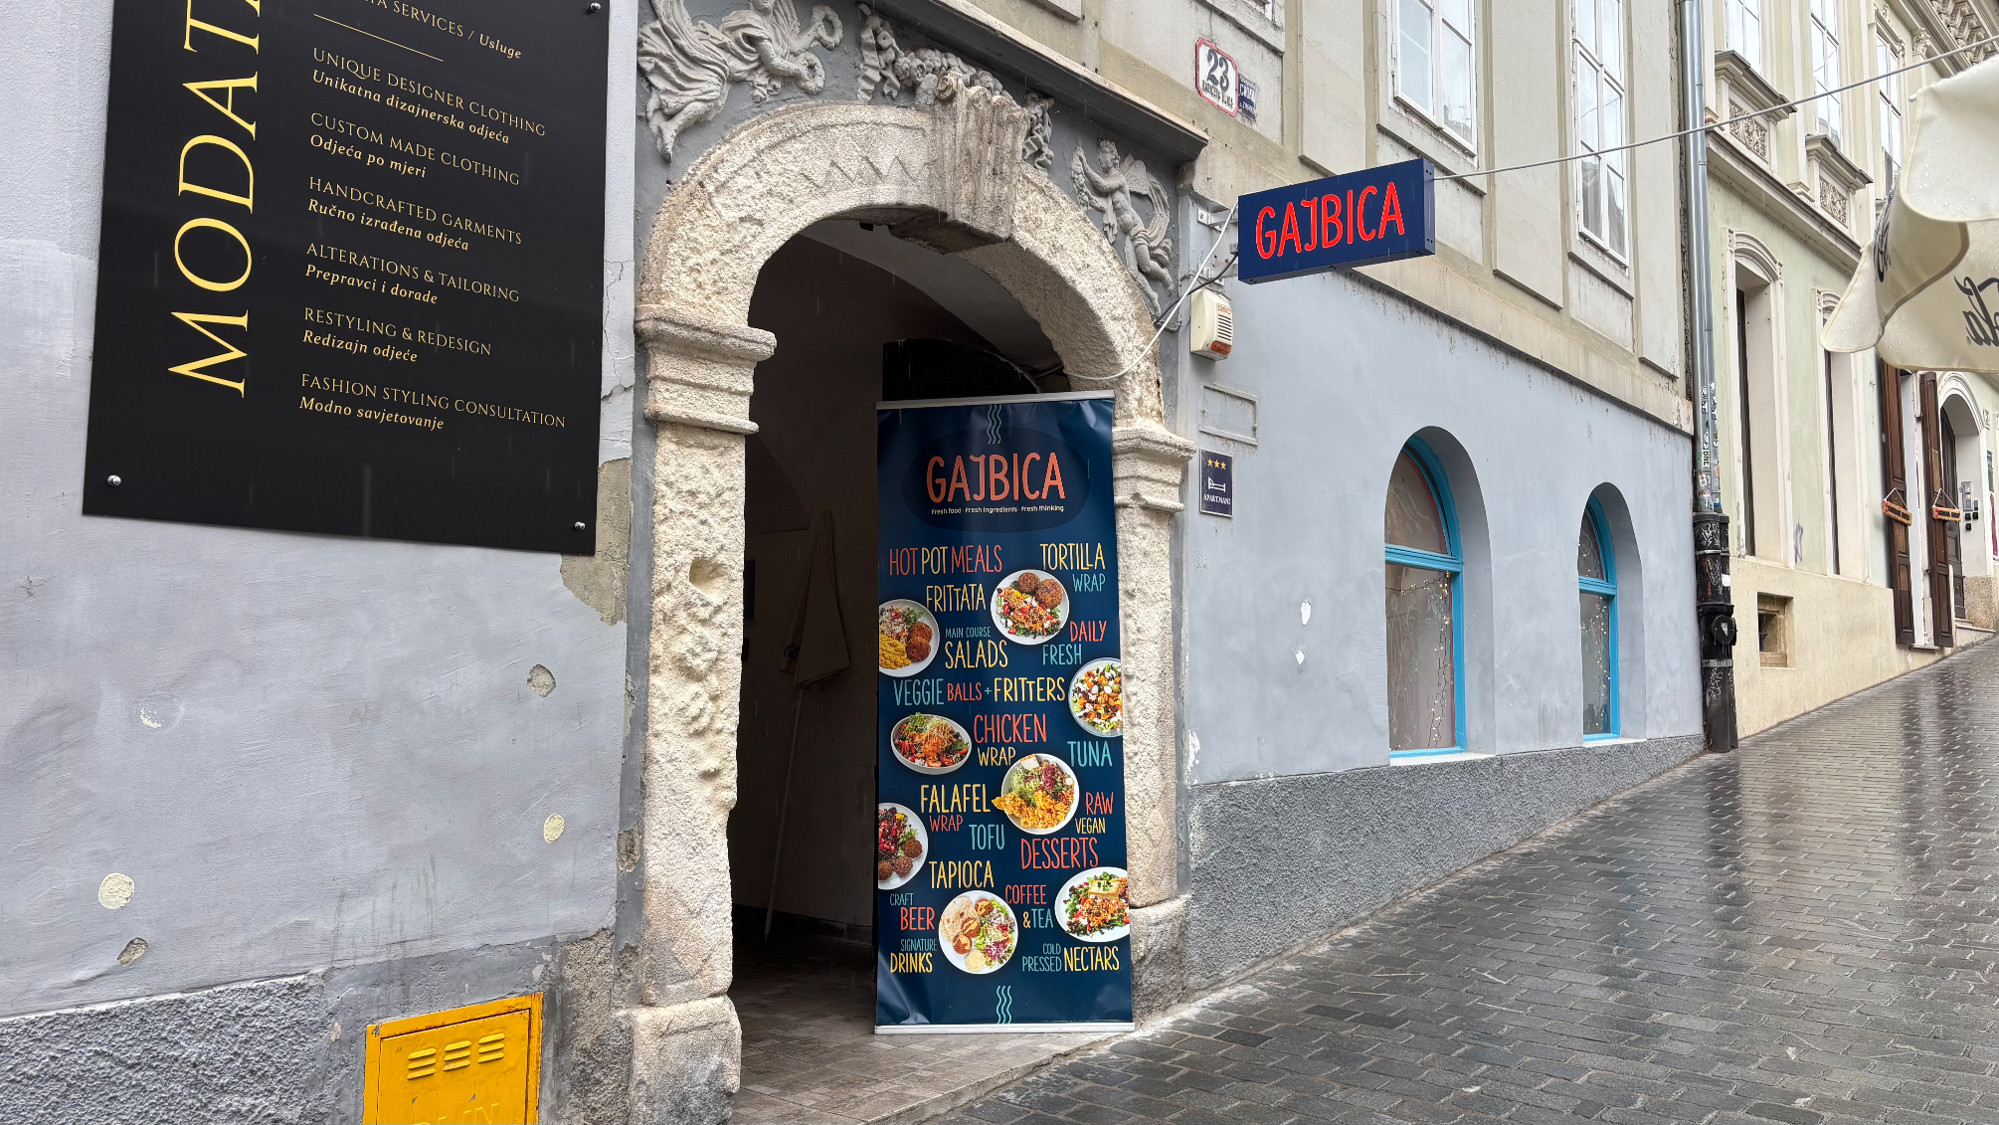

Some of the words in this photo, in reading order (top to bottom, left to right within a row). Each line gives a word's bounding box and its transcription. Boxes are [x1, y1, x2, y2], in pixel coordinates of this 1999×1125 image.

[393, 0, 464, 37] SERVICES
[479, 34, 522, 59] Usluge
[1207, 48, 1229, 92] 23
[313, 47, 381, 81] UNIQUE
[388, 72, 465, 110] DESIGNER
[469, 101, 546, 136] CLOTHING
[312, 69, 381, 102] Unikatna
[386, 95, 464, 129] dizajnerska
[469, 123, 509, 144] odjeća
[310, 112, 384, 145] CUSTOM
[390, 136, 436, 161] MADE
[440, 152, 520, 186] CLOTHING
[310, 134, 362, 160] Odjeća
[367, 153, 384, 166] po
[390, 159, 427, 179] mjeri
[168, 0, 261, 398] MODAT
[309, 176, 437, 222] HANDCRAFTED
[441, 213, 522, 245] GARMENTS
[308, 199, 355, 222] Ručno
[360, 213, 422, 239] izrađena
[426, 232, 469, 251] odjeća
[1255, 181, 1405, 260] GAJBICA
[306, 243, 419, 280] ALTERATIONS
[423, 269, 435, 283] &
[438, 272, 520, 303] TAILORING
[306, 264, 377, 291] Prepravci
[381, 280, 387, 293] i
[391, 283, 438, 304] dorade
[302, 329, 368, 354] Redizajn
[373, 345, 418, 363] odjeće
[304, 307, 397, 338] RESTYLING
[402, 327, 413, 341] &
[418, 329, 492, 356] REDESIGN
[299, 396, 352, 416] Modno
[356, 407, 445, 432] savjetovanje
[301, 373, 377, 398] FASHION
[383, 387, 449, 410] STYLING
[454, 399, 566, 428] CONSULTATION
[926, 452, 1065, 503] GAJBICA
[1038, 504, 1064, 512] thinking
[889, 547, 918, 576] HOT
[921, 546, 948, 575] POT
[951, 544, 1003, 574] MEALS
[1040, 542, 1106, 570] TORTILLA
[1072, 573, 1106, 593] WRAP
[926, 584, 986, 613] FRITTATA
[945, 627, 964, 638] MAIN
[966, 626, 991, 638] COURSE
[1070, 620, 1107, 642] DAILY
[945, 640, 1008, 669] SALADS
[1042, 644, 1082, 666] FRESH
[893, 678, 945, 706] VEGGIE
[947, 682, 982, 701] BALLS
[994, 677, 1065, 702] FRITTERS
[973, 714, 1047, 744] CHICKEN
[977, 747, 1016, 766] WRAP
[1067, 741, 1113, 768] TUNA
[920, 784, 991, 813] FALAFEL
[1086, 791, 1114, 815] RAW
[929, 815, 963, 833] WRAP
[969, 824, 1005, 850] TOFU
[1075, 817, 1106, 834] VEGAN
[1021, 837, 1099, 869] DESSERTS
[929, 860, 994, 889] TAPIOCA
[890, 892, 913, 906] CRAFT
[1005, 884, 1047, 905] COFFEE
[901, 907, 935, 931] BEER
[901, 938, 937, 952] SIGNATURE
[1022, 956, 1061, 972] PRESSED
[1064, 946, 1120, 972] NECTARS
[1042, 943, 1061, 955] COLD
[890, 953, 933, 973] DRINKS
